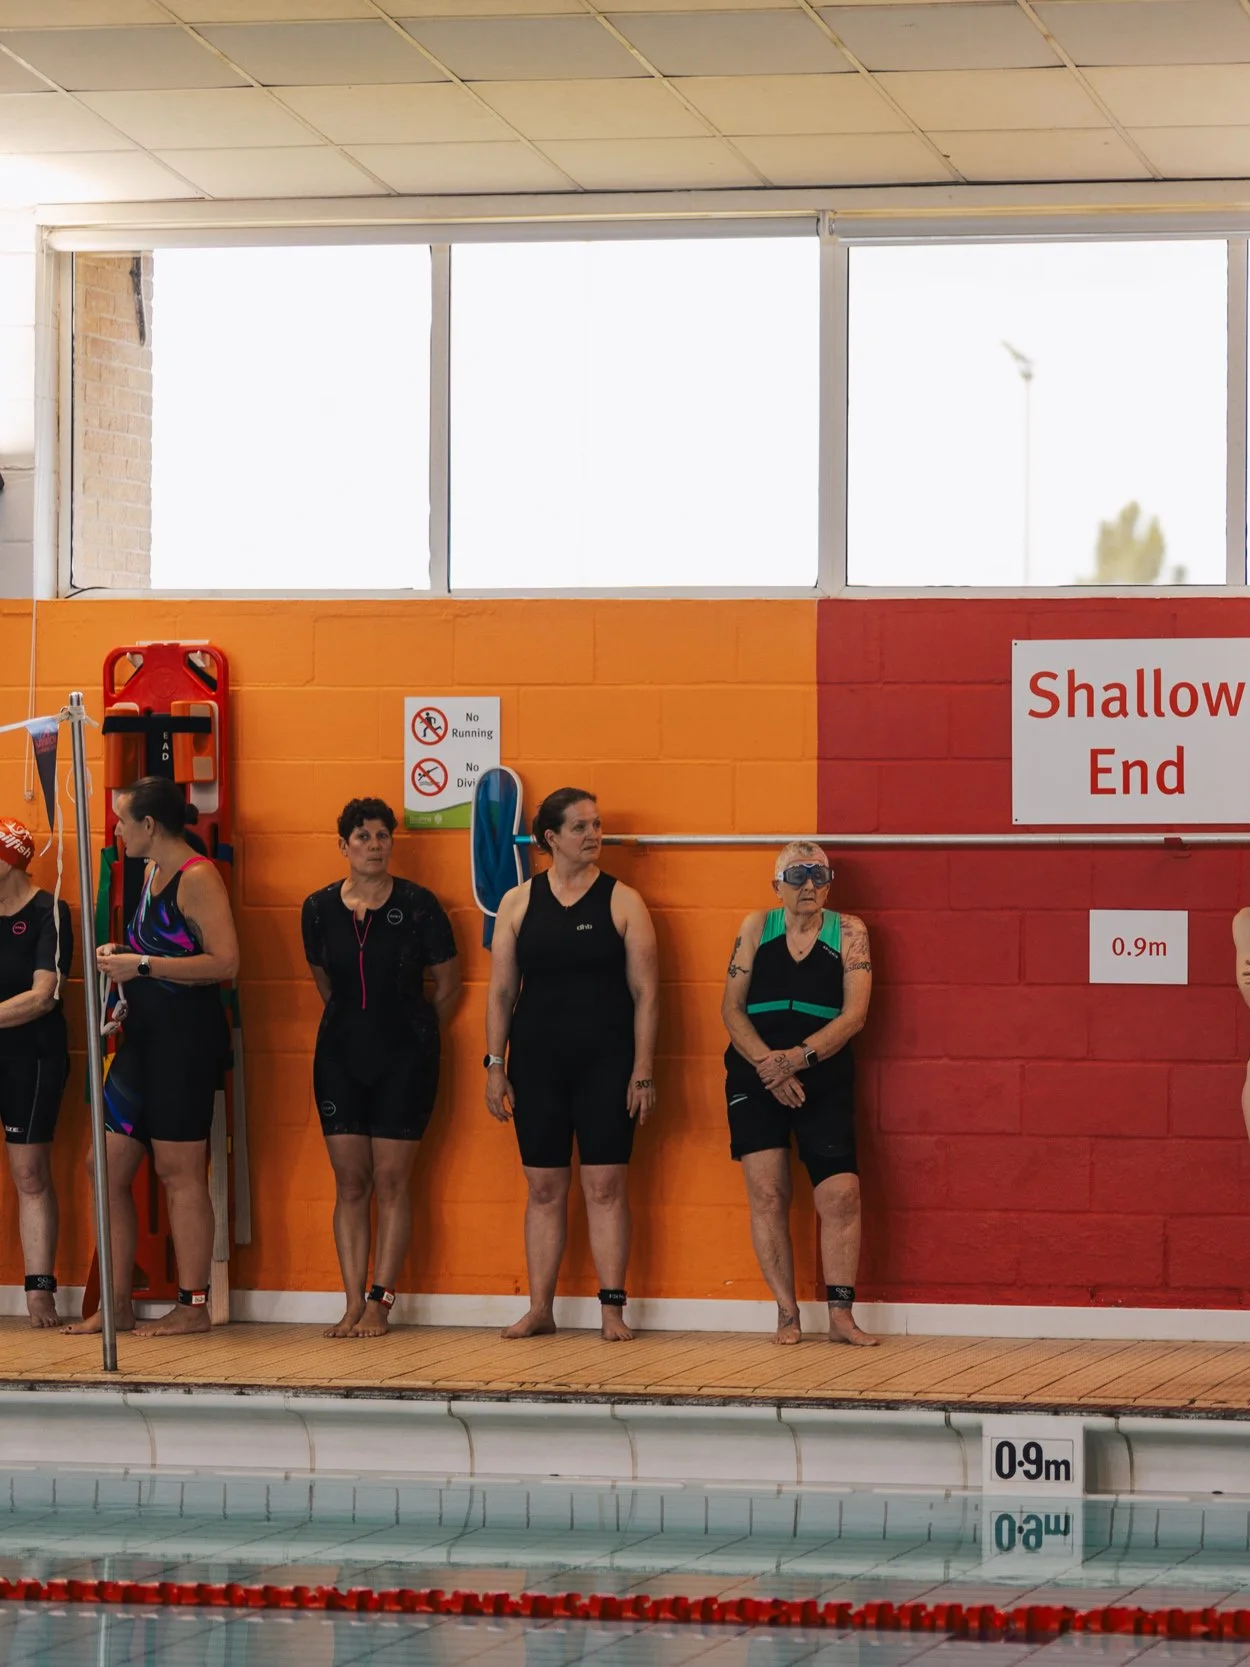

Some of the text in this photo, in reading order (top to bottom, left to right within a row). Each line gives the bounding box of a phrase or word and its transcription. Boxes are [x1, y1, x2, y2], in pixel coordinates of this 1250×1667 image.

[1028, 667, 1246, 720] Shallow
[465, 712, 480, 722] No
[451, 728, 494, 740] Running
[161, 731, 170, 761] EAD
[465, 761, 480, 772] No
[1088, 744, 1187, 796] End
[456, 777, 476, 788] Divi
[1111, 937, 1168, 958] 0.9m
